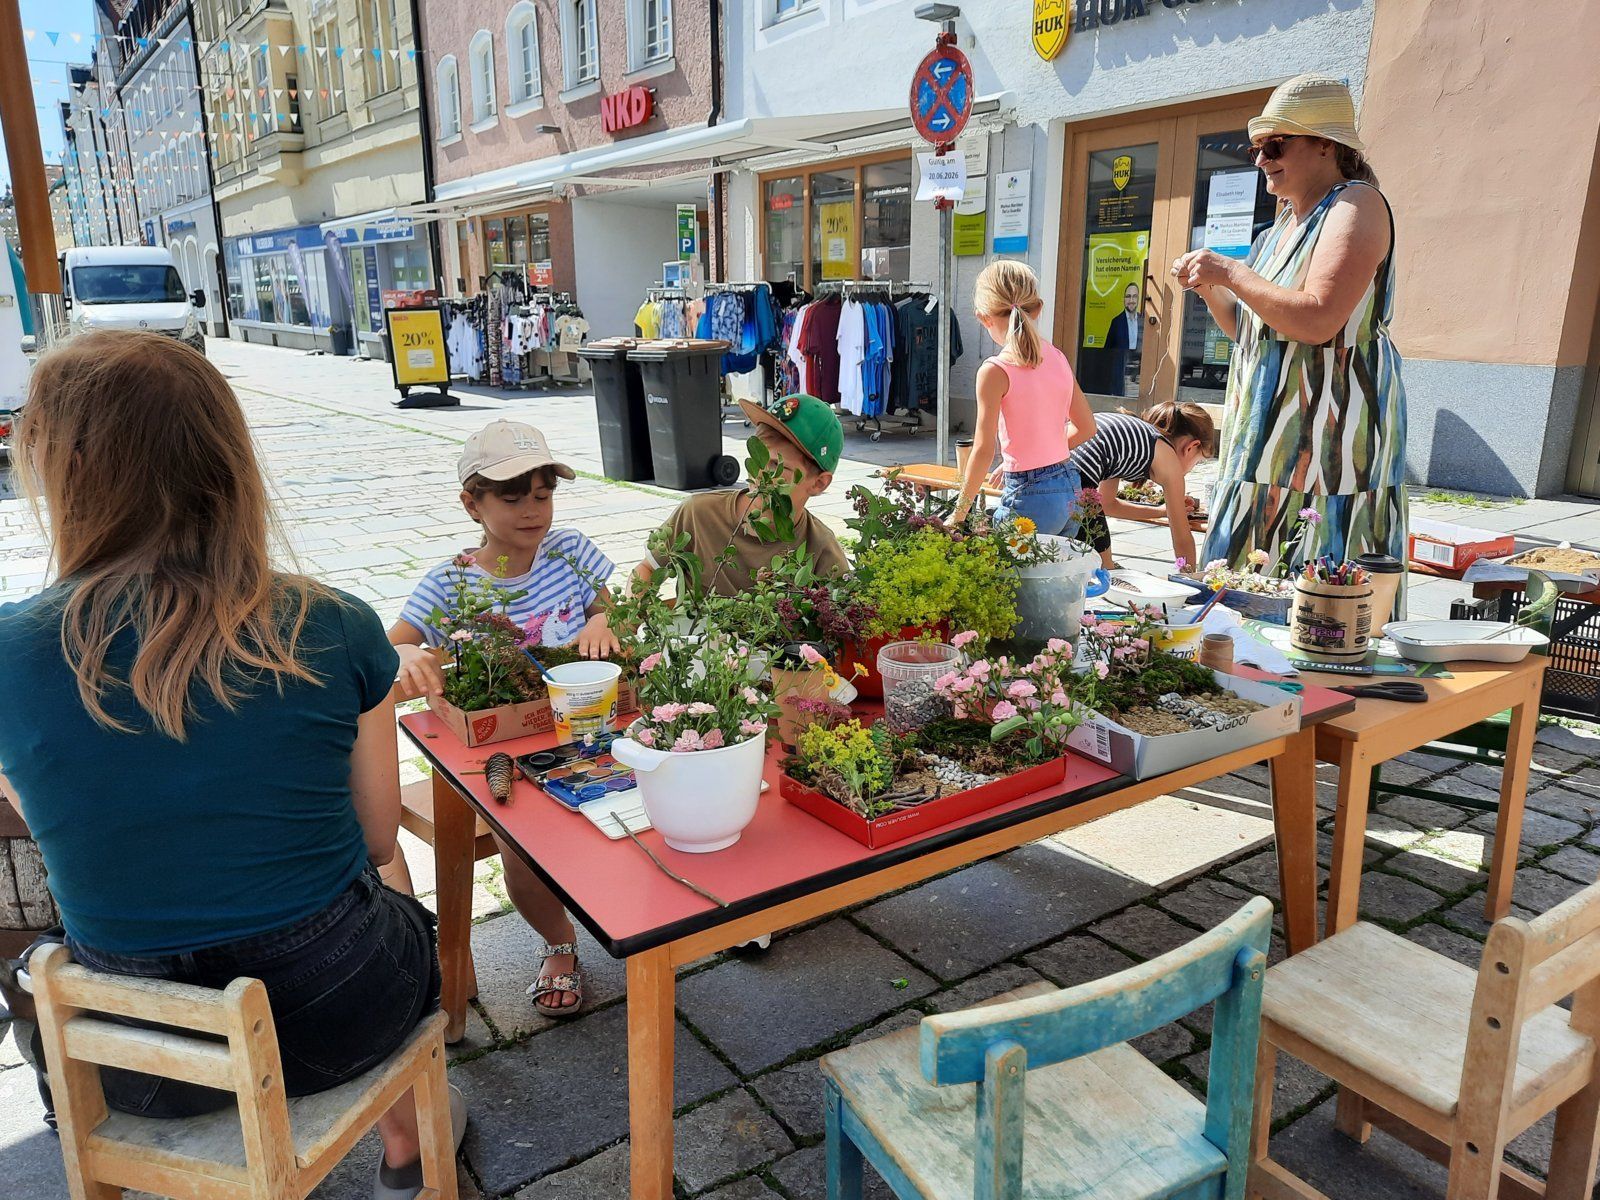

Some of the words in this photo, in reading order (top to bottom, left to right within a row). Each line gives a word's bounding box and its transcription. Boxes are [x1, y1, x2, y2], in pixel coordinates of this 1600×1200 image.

[1034, 17, 1064, 36] HUK
[601, 86, 647, 132] NKD
[928, 158, 946, 167] Gültig
[928, 171, 959, 180] 20.06.2026
[1114, 170, 1130, 179] HUK
[826, 217, 848, 234] 20%
[682, 238, 692, 252] P
[401, 330, 435, 347] 20%
[1291, 660, 1363, 671] ETTERLING
[524, 712, 535, 720] ICH
